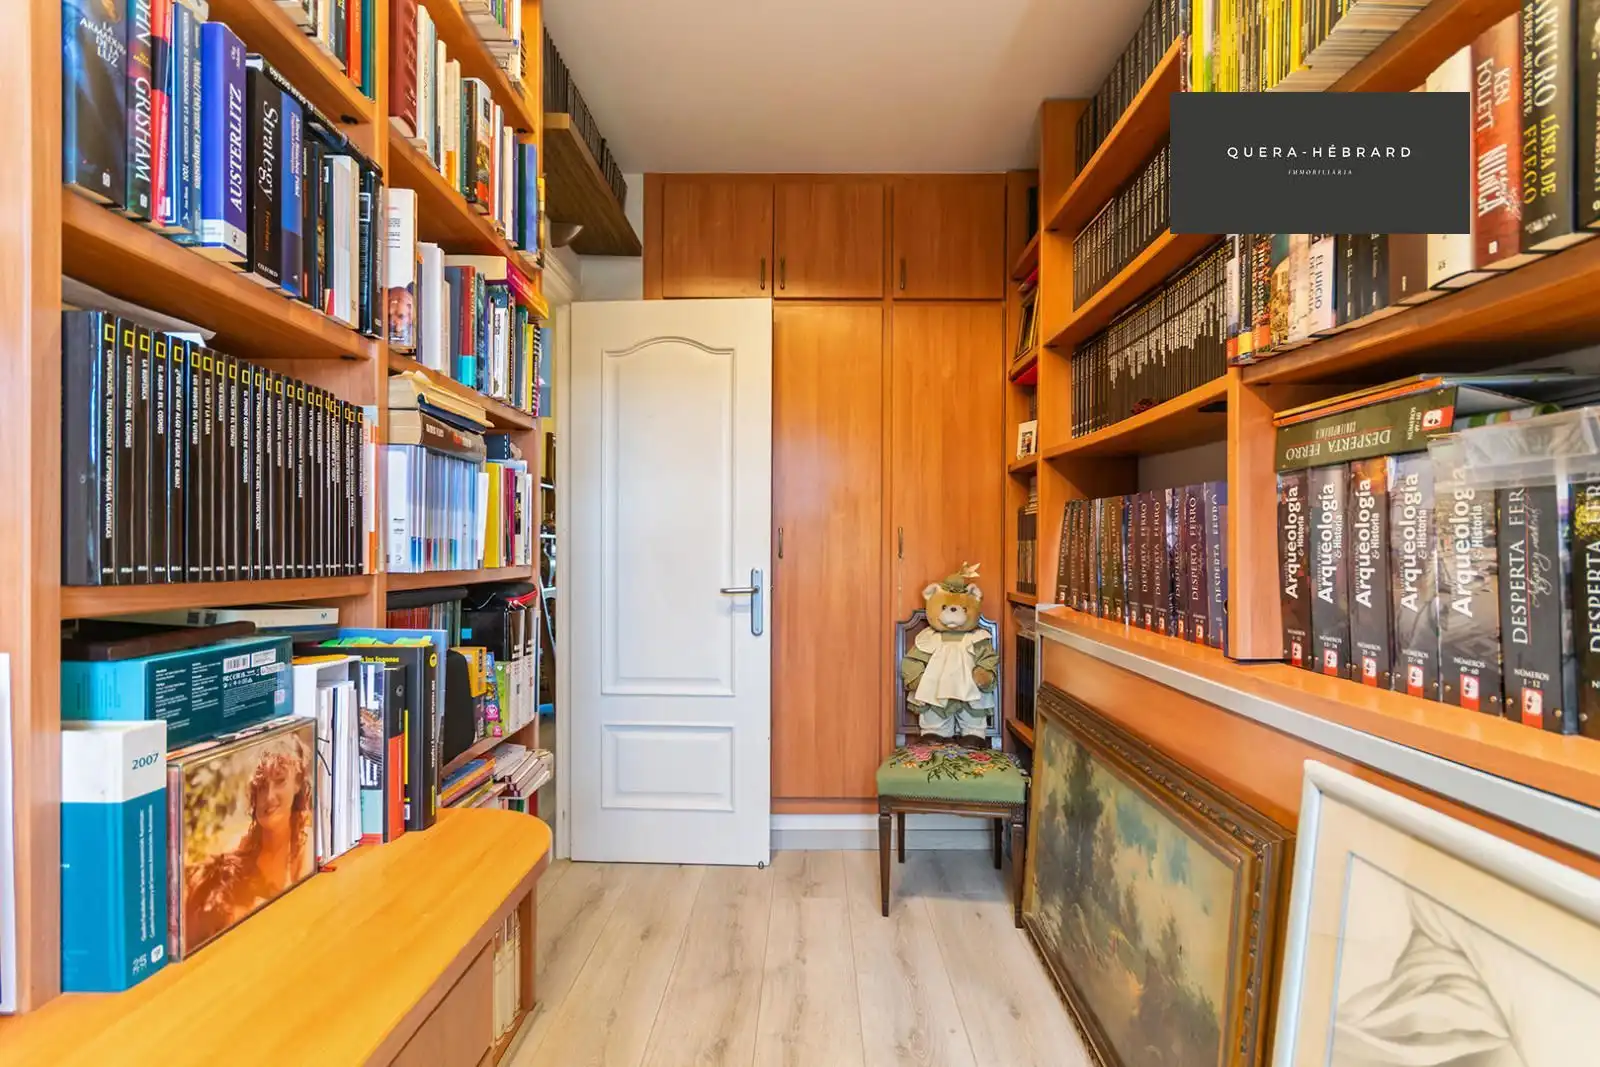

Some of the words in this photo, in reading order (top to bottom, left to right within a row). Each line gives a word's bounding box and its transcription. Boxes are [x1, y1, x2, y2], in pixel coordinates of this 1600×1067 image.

[135, 0, 151, 48] HN
[1476, 58, 1494, 132] FOLLETT
[1494, 66, 1511, 106] KEN
[135, 77, 151, 182] GRISHAM
[229, 83, 242, 213] AUSTERLITZ
[1540, 114, 1560, 170] LÍNEA
[258, 100, 279, 202] Strategy
[1523, 123, 1537, 204] FUEGO
[1478, 144, 1509, 217] NUNCA
[1540, 172, 1556, 197] DE
[257, 263, 279, 277] OXFORD
[1316, 254, 1324, 267] EL
[1315, 269, 1324, 309] JUICIO
[126, 354, 132, 364] LA
[158, 391, 164, 400] EN
[158, 401, 164, 409] EL
[175, 429, 181, 438] EN
[1286, 443, 1320, 461] FERRO
[1327, 430, 1391, 453] DESPERTA
[175, 459, 181, 467] DE
[1189, 497, 1197, 535] FERRO
[1508, 488, 1526, 526] FER
[1285, 486, 1301, 599] Arqueología
[1317, 482, 1337, 604] Arqueología
[1333, 514, 1343, 548] Historia
[1355, 478, 1375, 608] Arqueología
[1398, 473, 1422, 613] Arqueología
[1417, 509, 1427, 549] Historia
[1449, 467, 1475, 618] Arqueología
[1471, 504, 1482, 549] Historia
[1298, 547, 1304, 556] &
[1335, 548, 1342, 559] &
[1373, 550, 1380, 560] &
[1417, 550, 1428, 560] &
[1190, 543, 1199, 600] DESPERTA
[1508, 539, 1529, 645] DESPERTA
[1453, 656, 1486, 669] NÚMEROS
[1513, 666, 1551, 682] NÚMEROS
[132, 752, 160, 770] 2007
